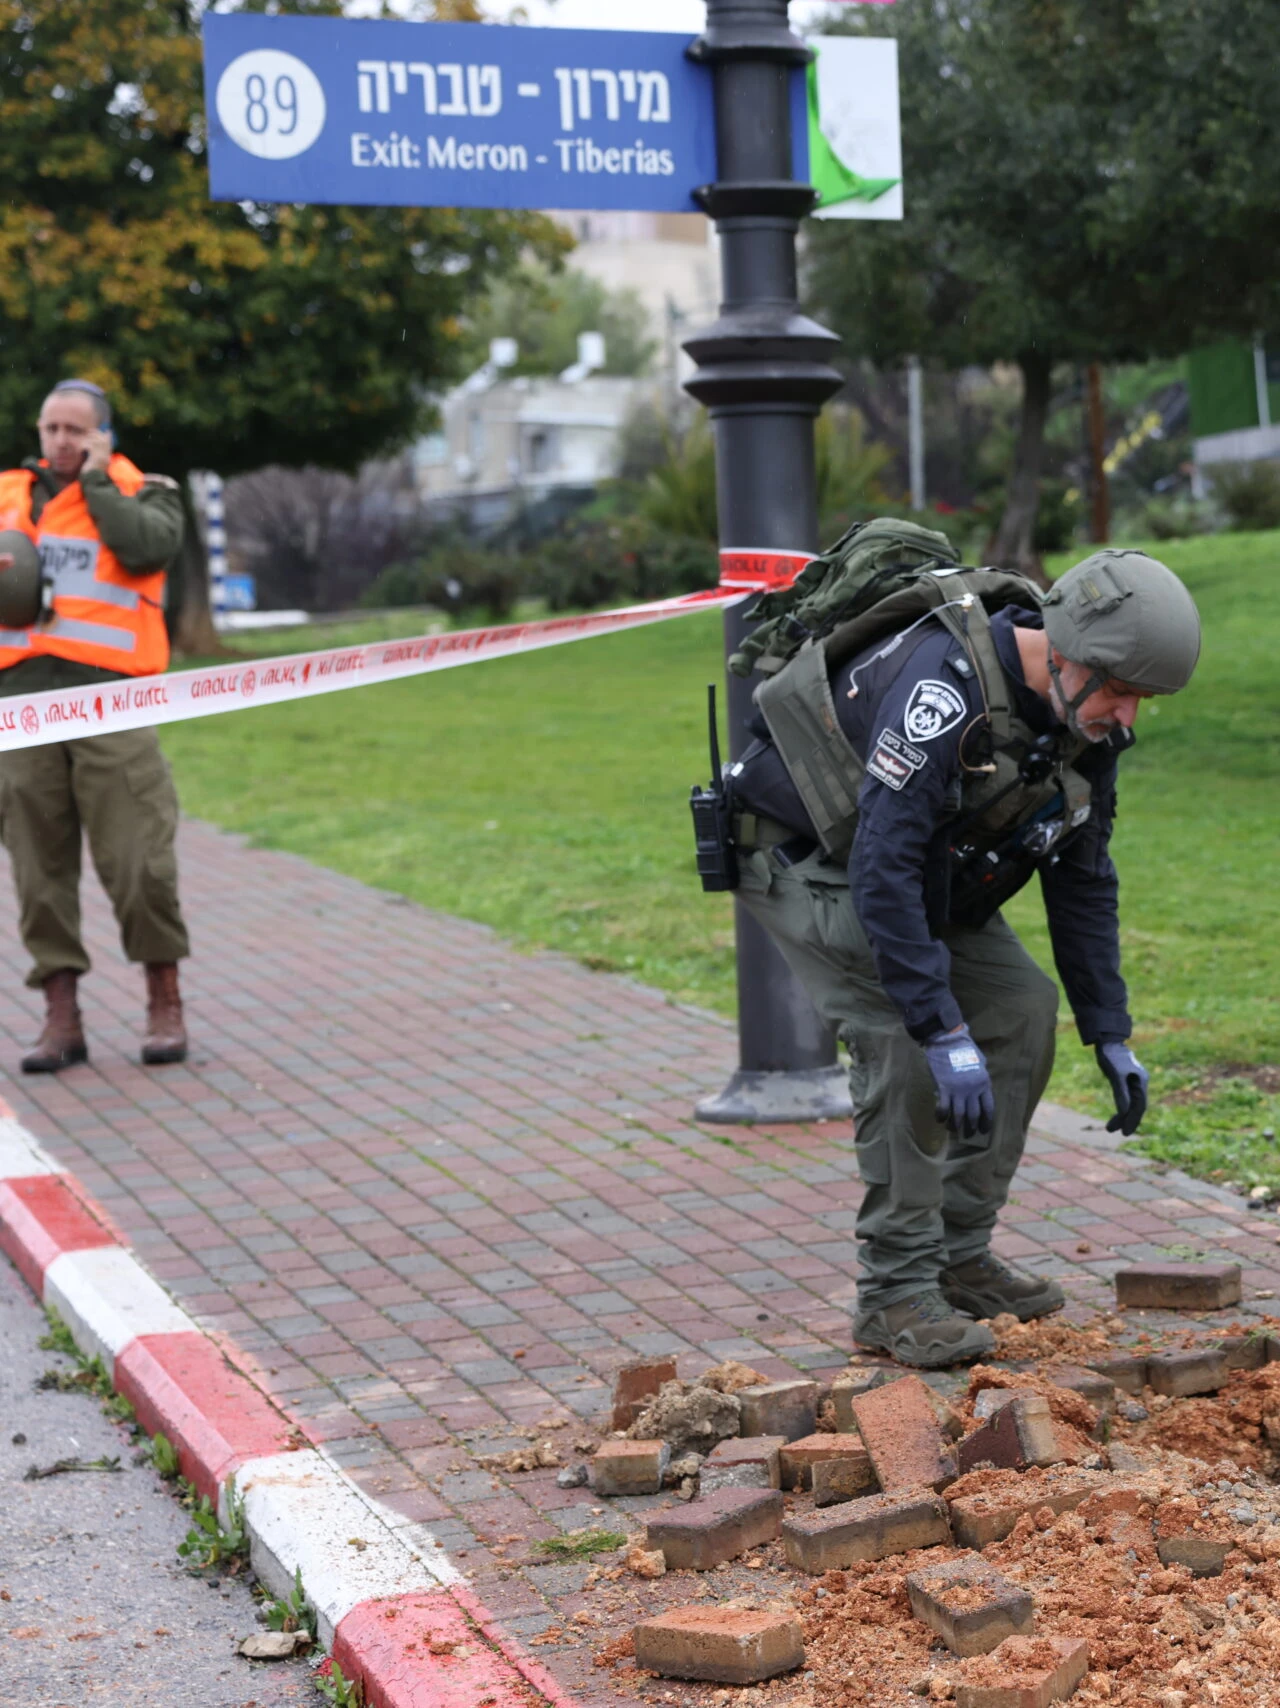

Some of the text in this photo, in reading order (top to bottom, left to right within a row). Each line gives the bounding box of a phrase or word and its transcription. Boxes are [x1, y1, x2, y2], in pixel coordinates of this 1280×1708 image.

[246, 74, 298, 135] 89
[357, 60, 501, 117] טבריה
[553, 67, 671, 131] מירון
[351, 131, 421, 169] Exit:
[426, 135, 528, 171] Meron
[553, 137, 675, 176] Tiberias
[45, 687, 168, 723] ישראל אין מעבר
[191, 675, 236, 698] משטרת
[261, 665, 298, 686] ישראל
